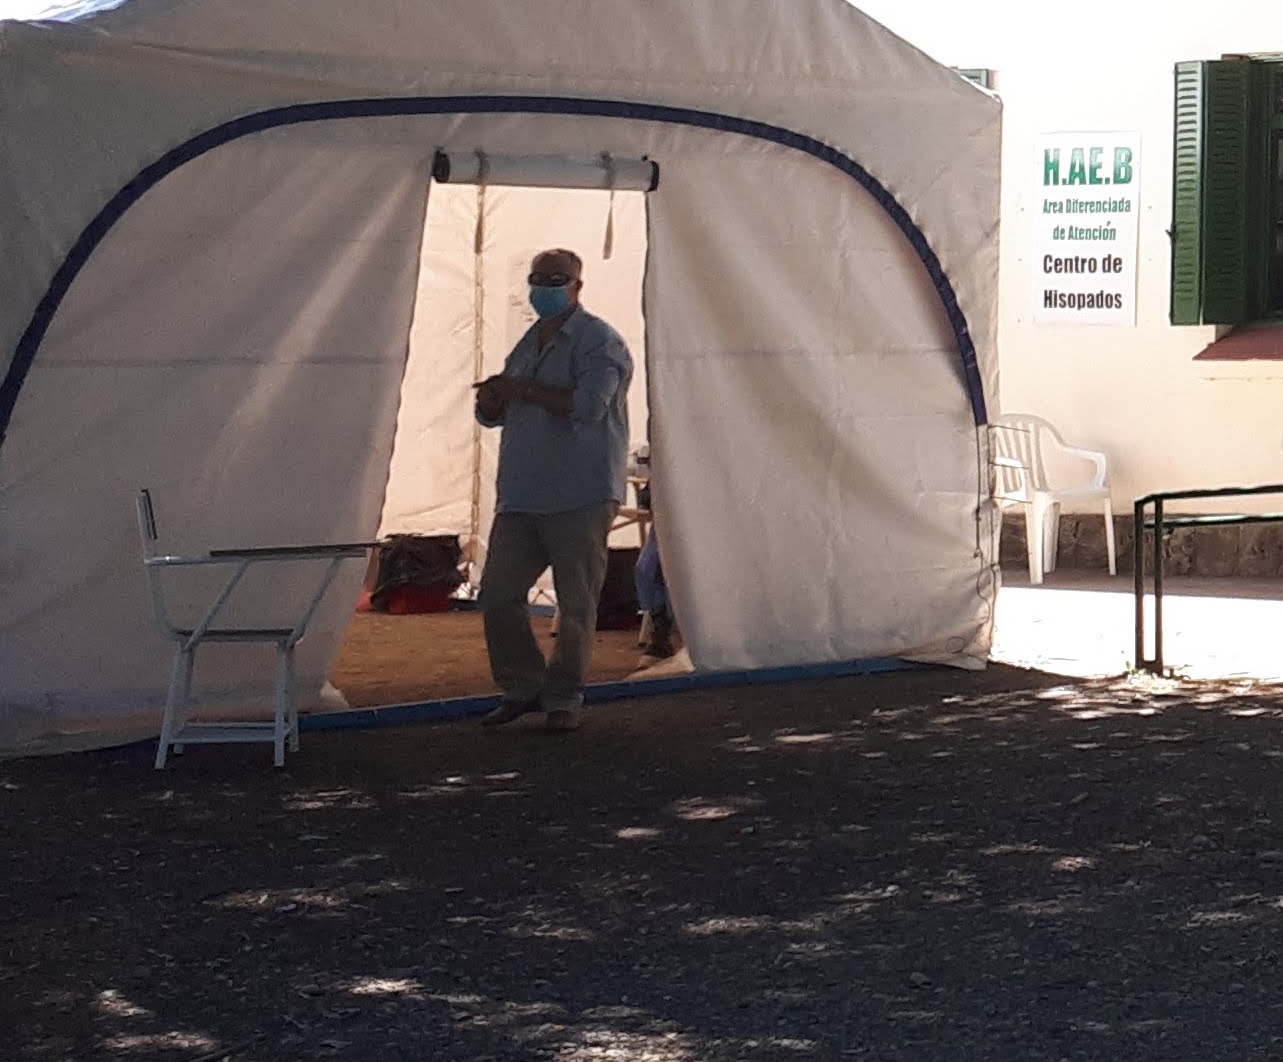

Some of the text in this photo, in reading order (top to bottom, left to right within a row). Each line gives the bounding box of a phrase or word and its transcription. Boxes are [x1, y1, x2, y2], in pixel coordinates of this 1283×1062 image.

[1066, 197, 1131, 214] Diferenciada
[1053, 221, 1117, 241] de Atención
[1043, 254, 1123, 274] Centro de
[1043, 289, 1123, 311] Hisopados
